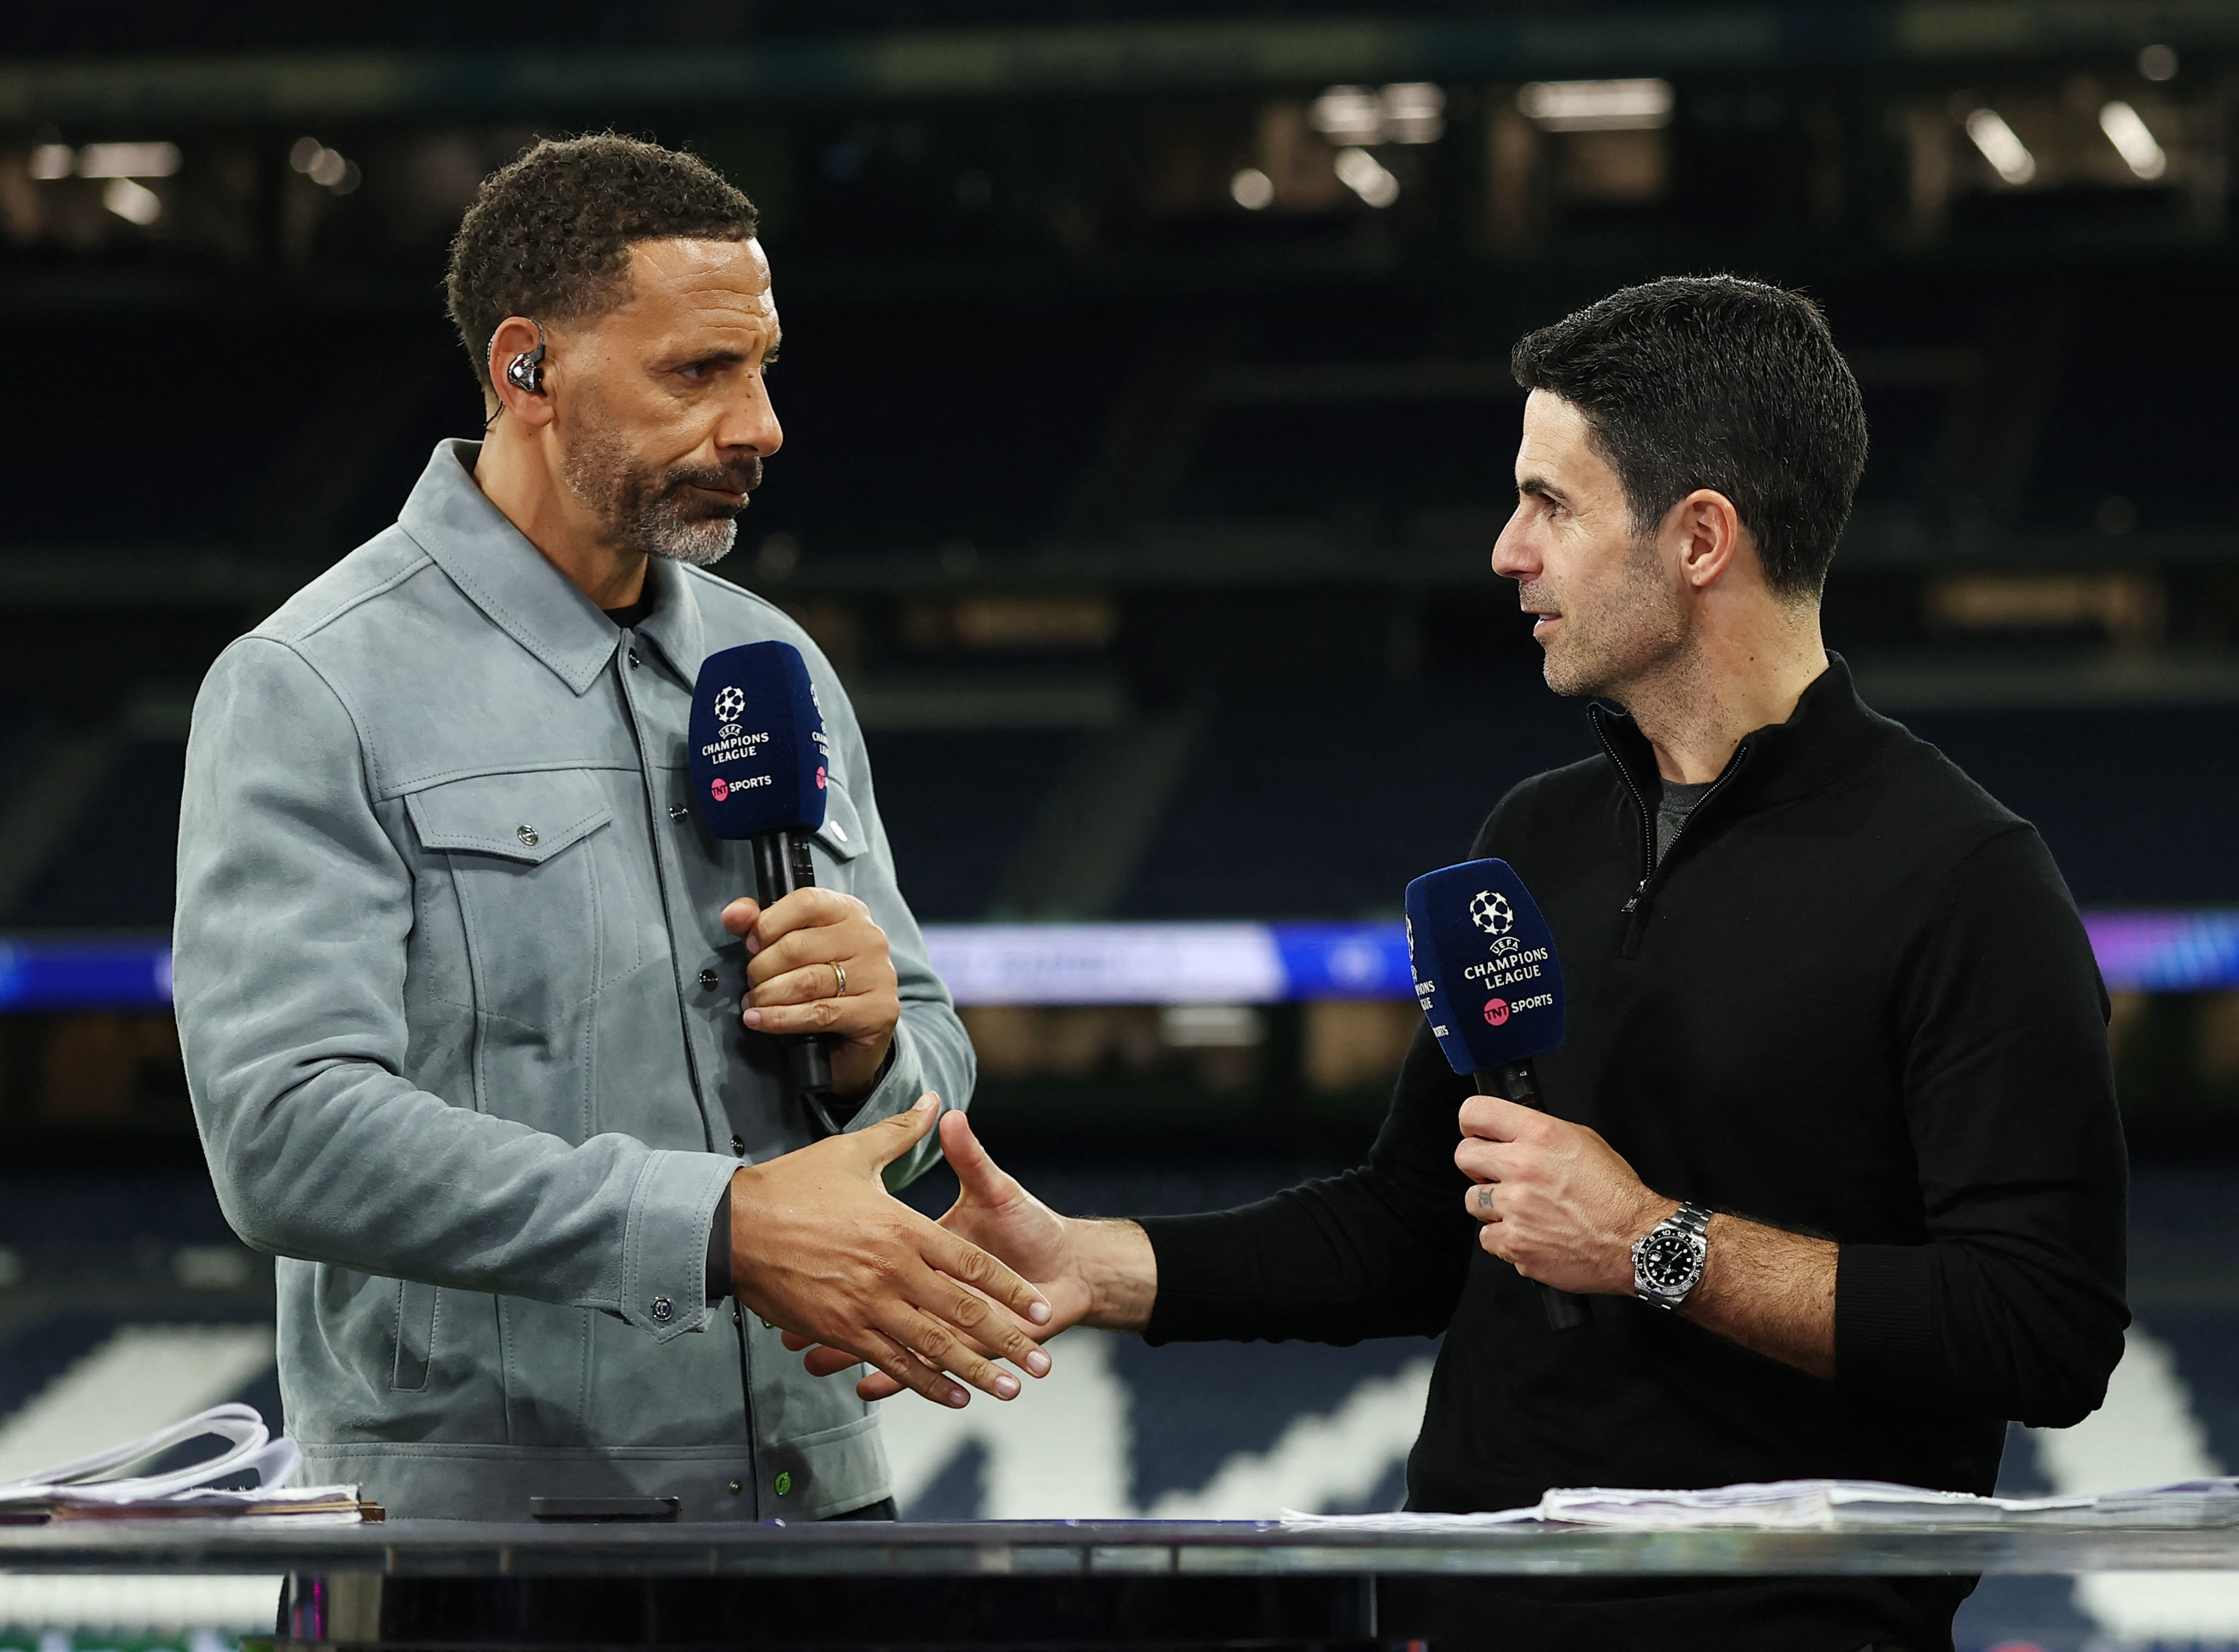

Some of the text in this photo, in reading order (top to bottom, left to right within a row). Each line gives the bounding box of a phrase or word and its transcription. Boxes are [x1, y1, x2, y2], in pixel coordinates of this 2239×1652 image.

[719, 726, 741, 738] UEFA
[702, 732, 770, 756] CHAMPIONS
[712, 745, 757, 765] LEAGUE
[729, 775, 772, 793] SPORTS
[1492, 939, 1519, 954] UEFA
[1464, 947, 1549, 980] CHAMPIONS
[1484, 964, 1541, 990] LEAGUE
[1484, 993, 1553, 1021] TNT SPORTS
